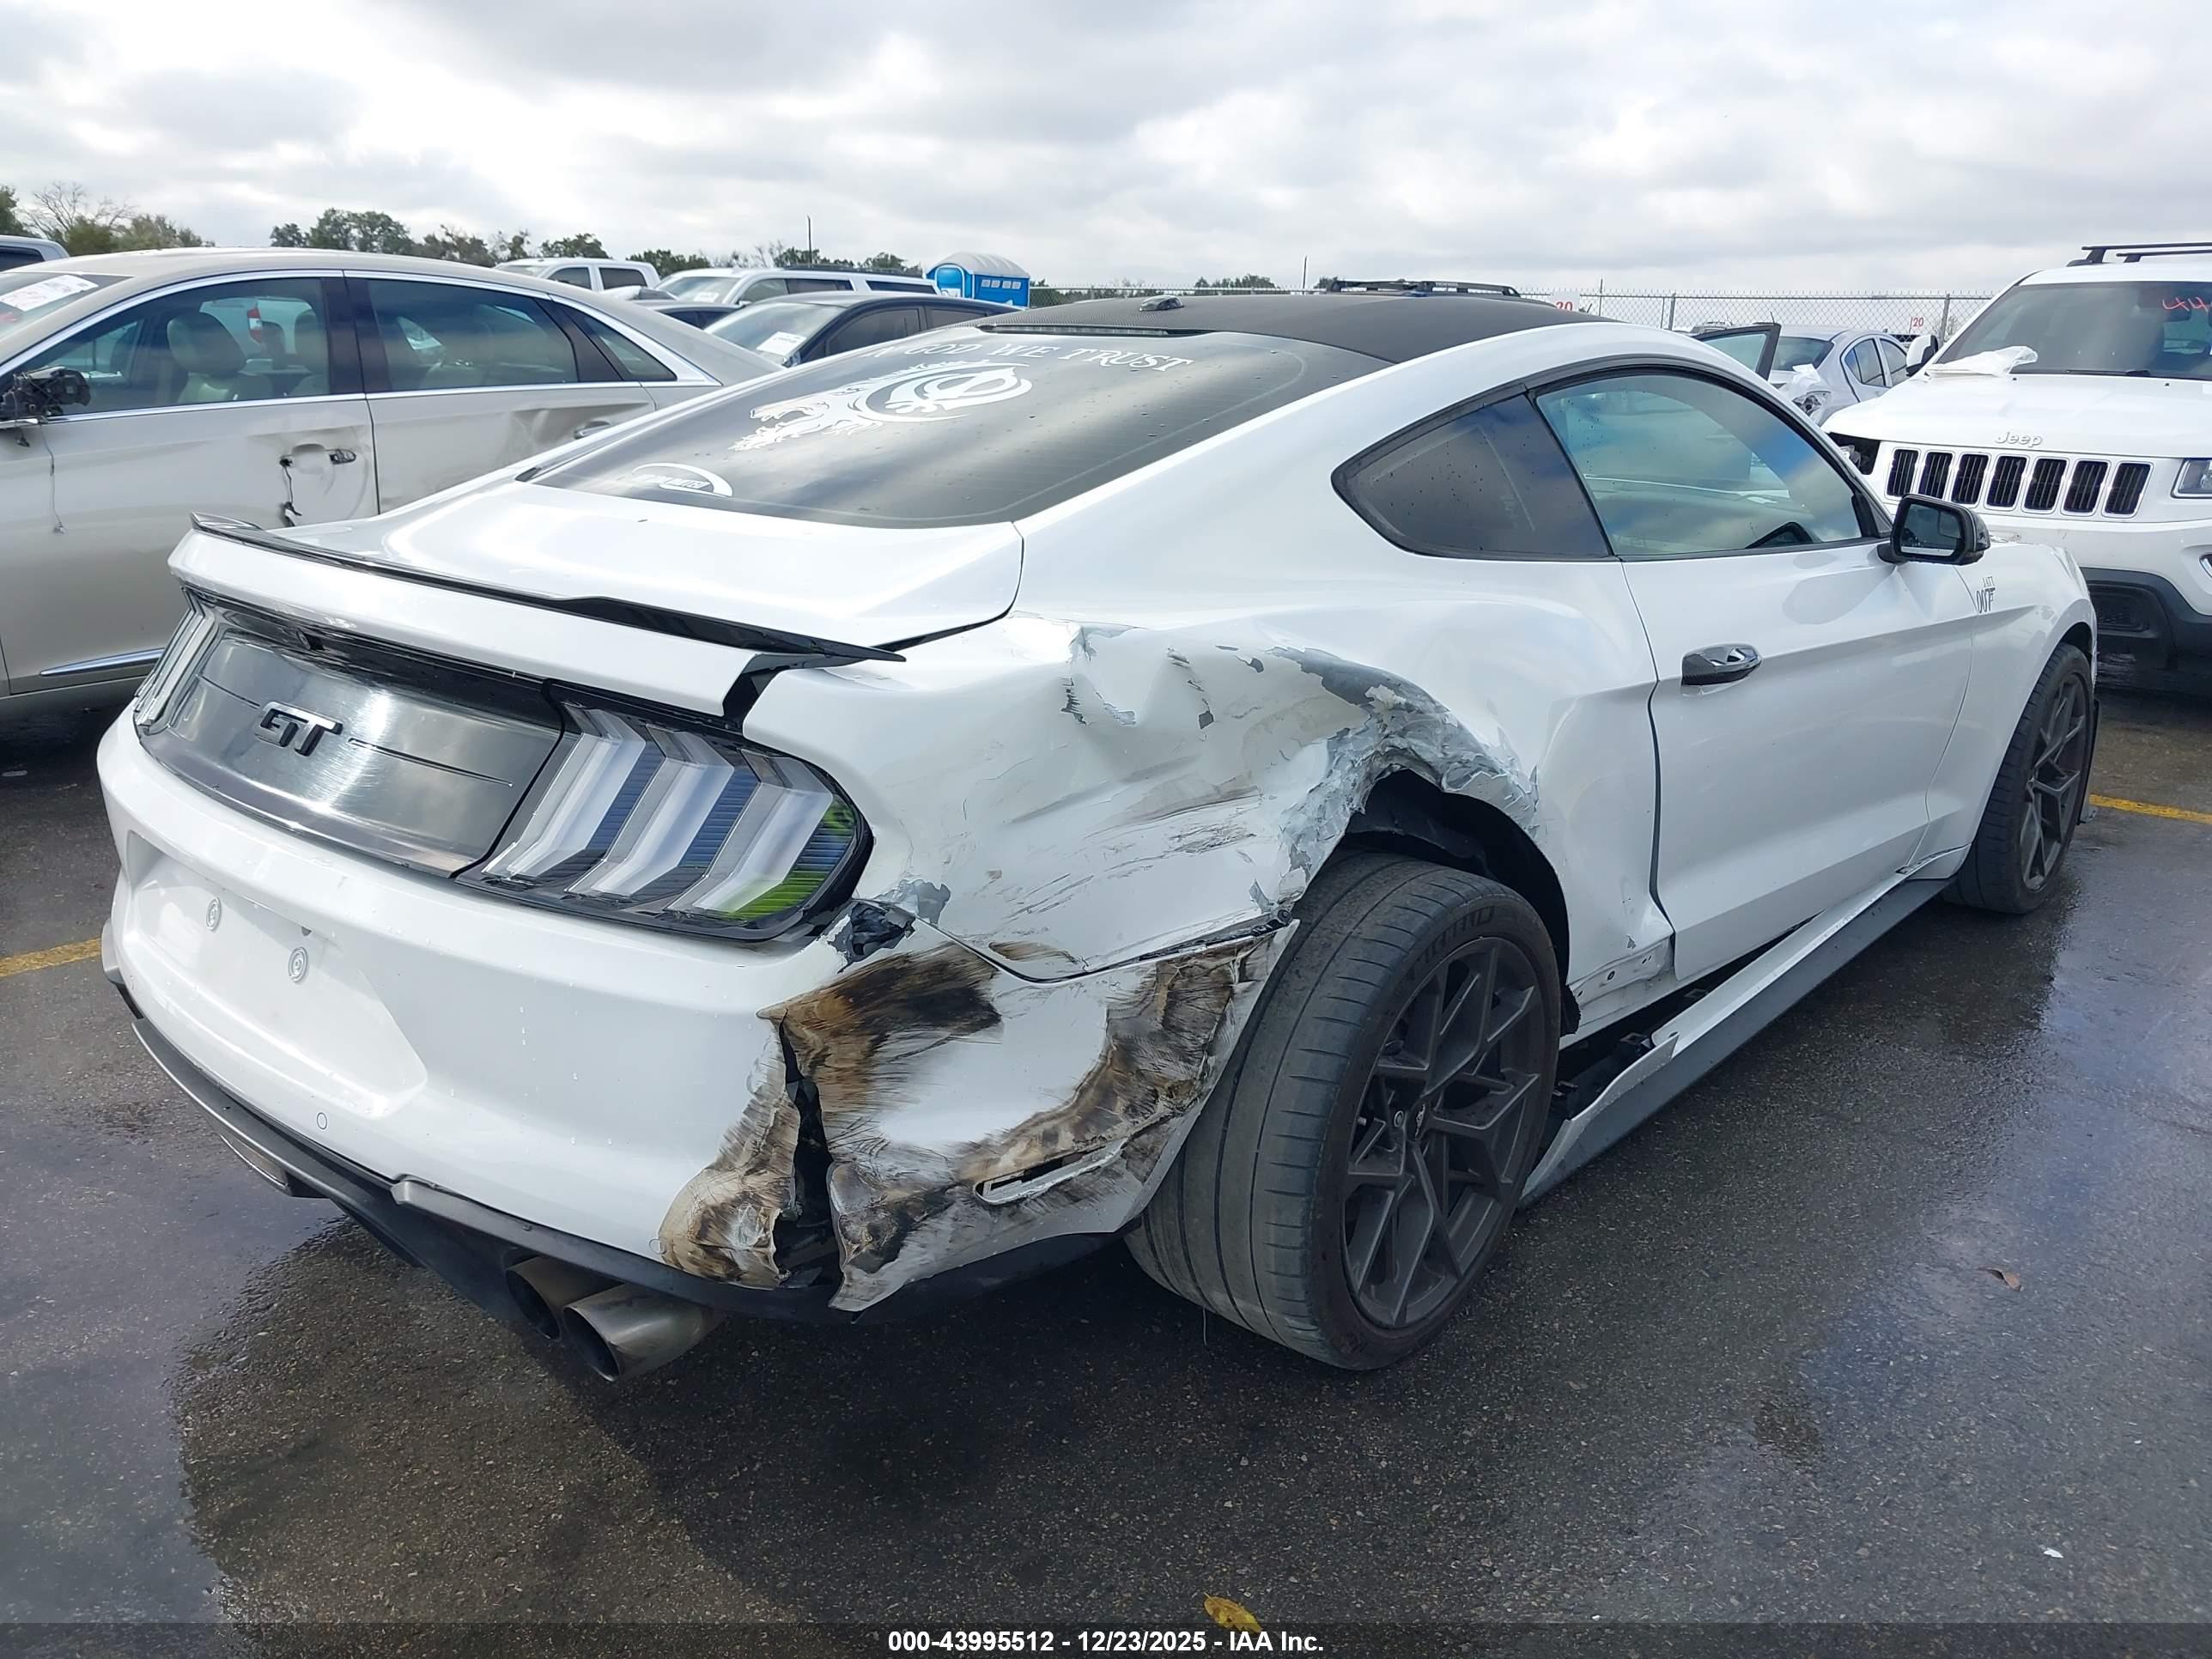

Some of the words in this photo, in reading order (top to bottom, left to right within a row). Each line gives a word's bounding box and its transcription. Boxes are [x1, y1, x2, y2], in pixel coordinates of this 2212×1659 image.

[2162, 296, 2212, 312] 44
[904, 343, 982, 354] GOD
[988, 343, 1060, 357] WE
[1058, 348, 1194, 371] TRUST
[1995, 431, 2043, 447] Jeep
[258, 702, 343, 757] GT
